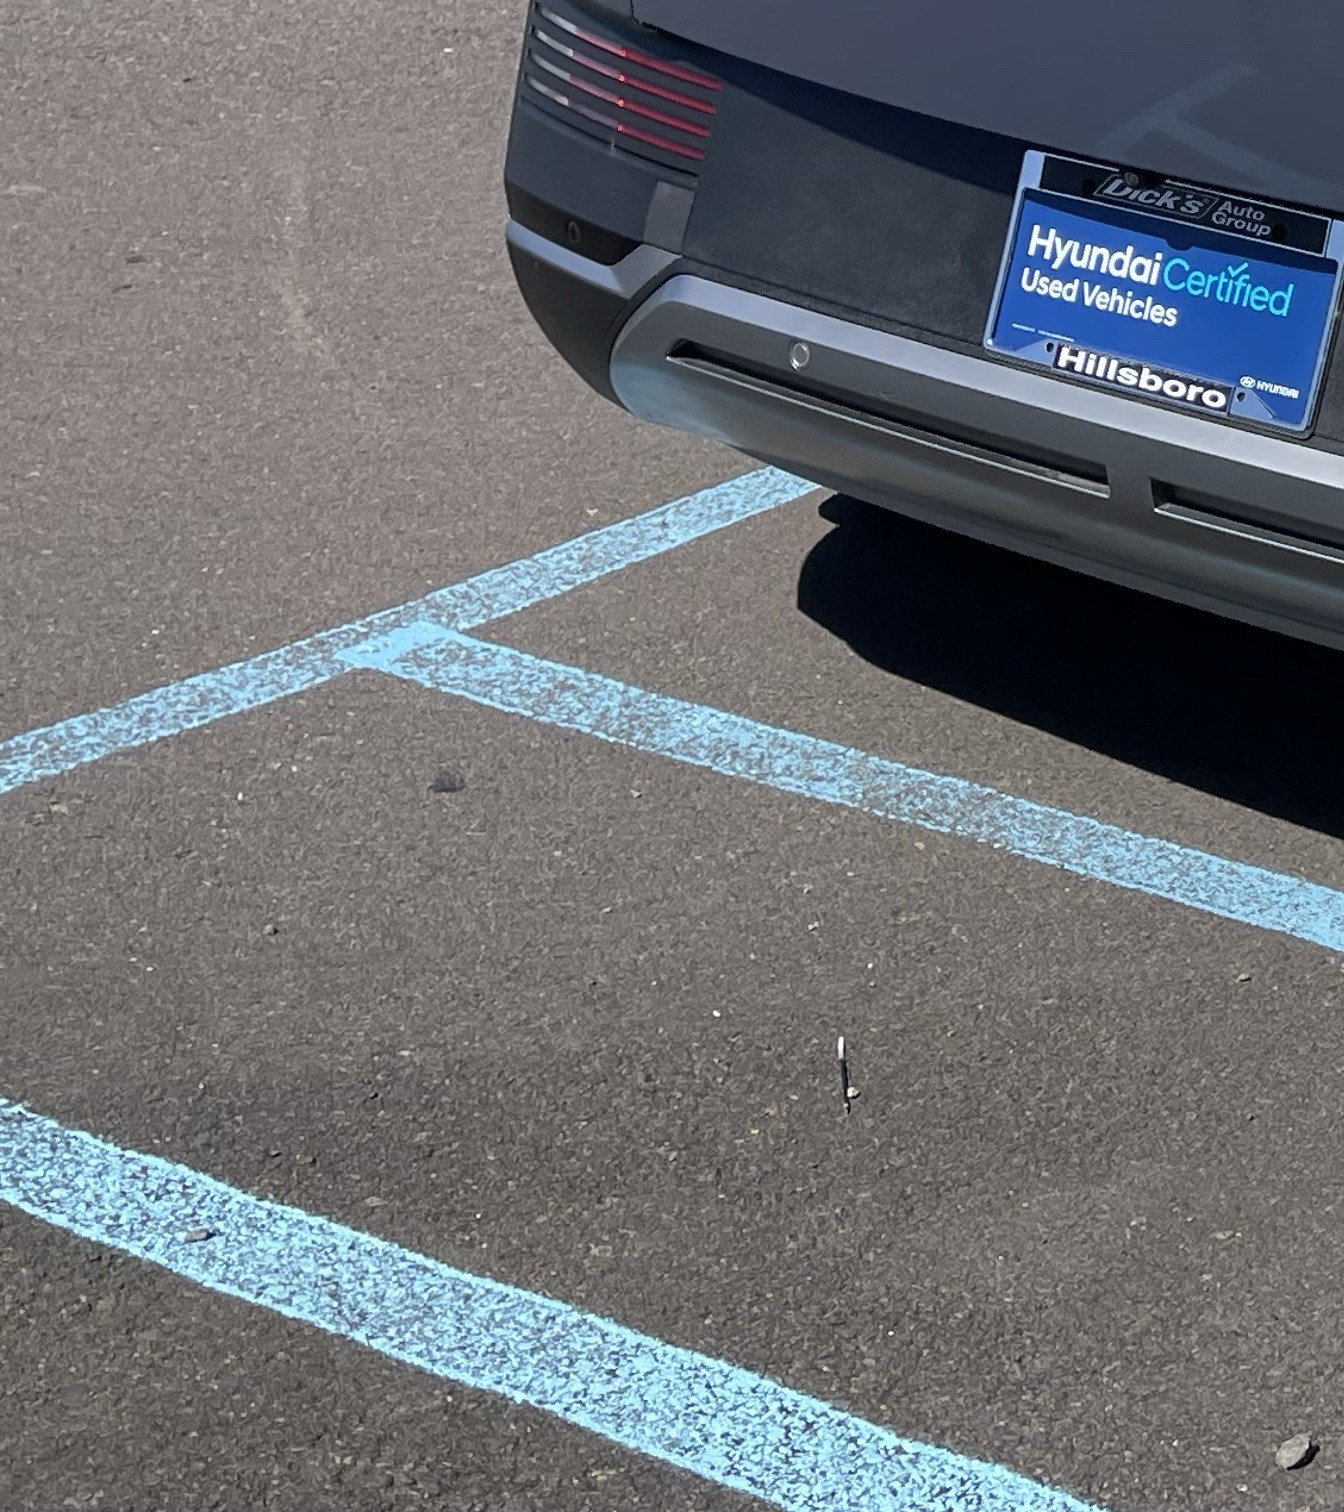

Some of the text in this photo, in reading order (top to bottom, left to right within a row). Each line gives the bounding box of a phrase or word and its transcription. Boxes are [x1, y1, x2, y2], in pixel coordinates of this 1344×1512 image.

[1211, 211, 1272, 237] Group
[1217, 200, 1266, 222] Auto
[1027, 223, 1294, 317] Hyundai Certified
[1020, 267, 1178, 327] Used Vehicles
[1056, 345, 1227, 409] Hillsboro
[1256, 380, 1300, 400] HYUNDAI
